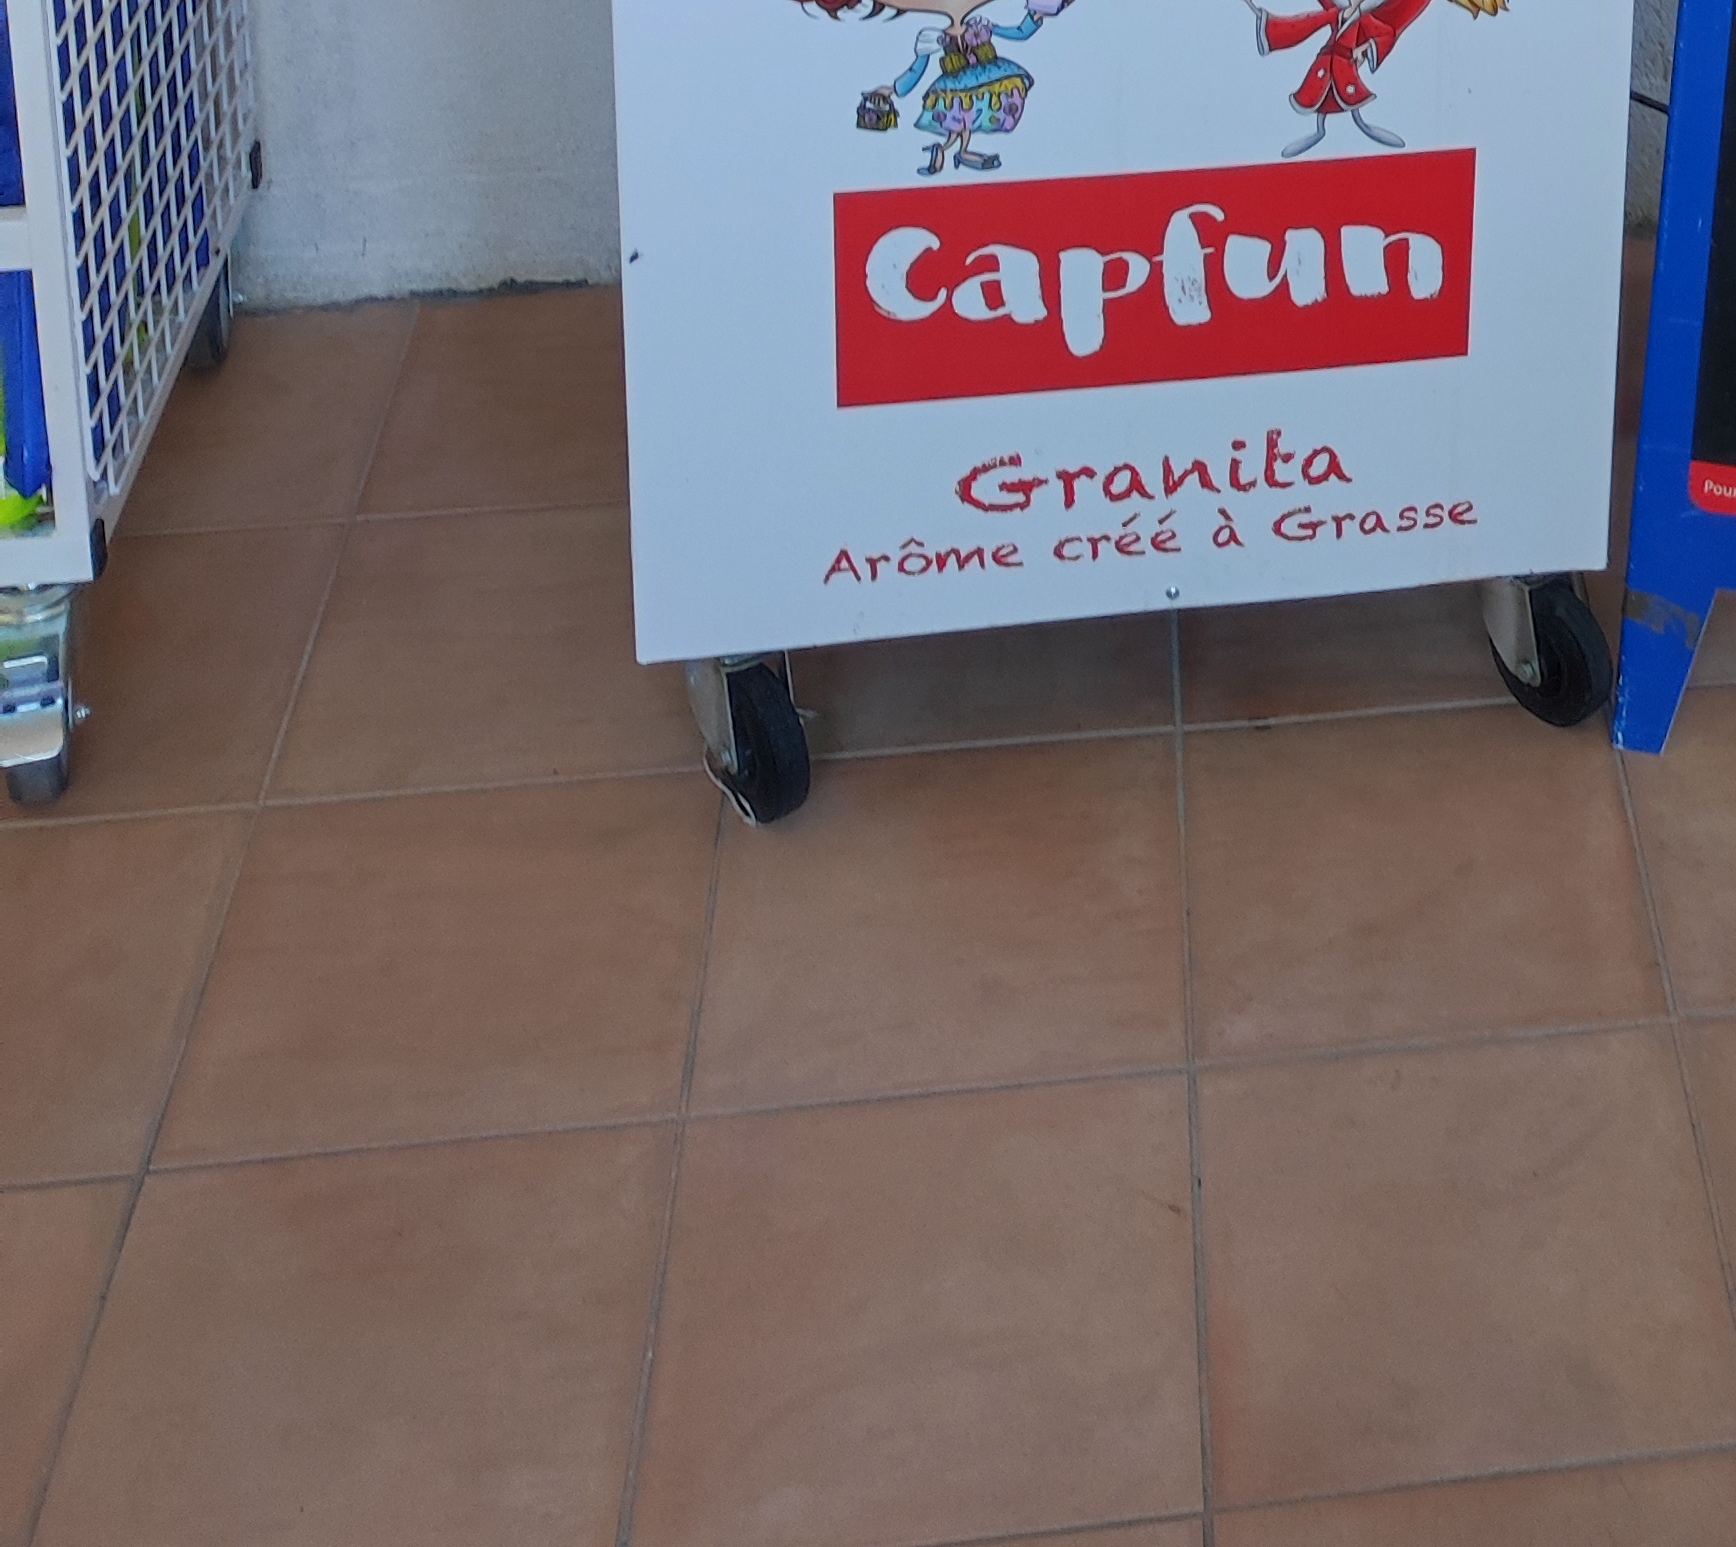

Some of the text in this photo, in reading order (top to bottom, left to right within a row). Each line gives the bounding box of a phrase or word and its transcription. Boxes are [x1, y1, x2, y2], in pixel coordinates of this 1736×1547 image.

[864, 201, 1445, 358] Capfun
[955, 427, 1353, 513] Granita
[822, 496, 1479, 586] Arôme créé à Grasse
